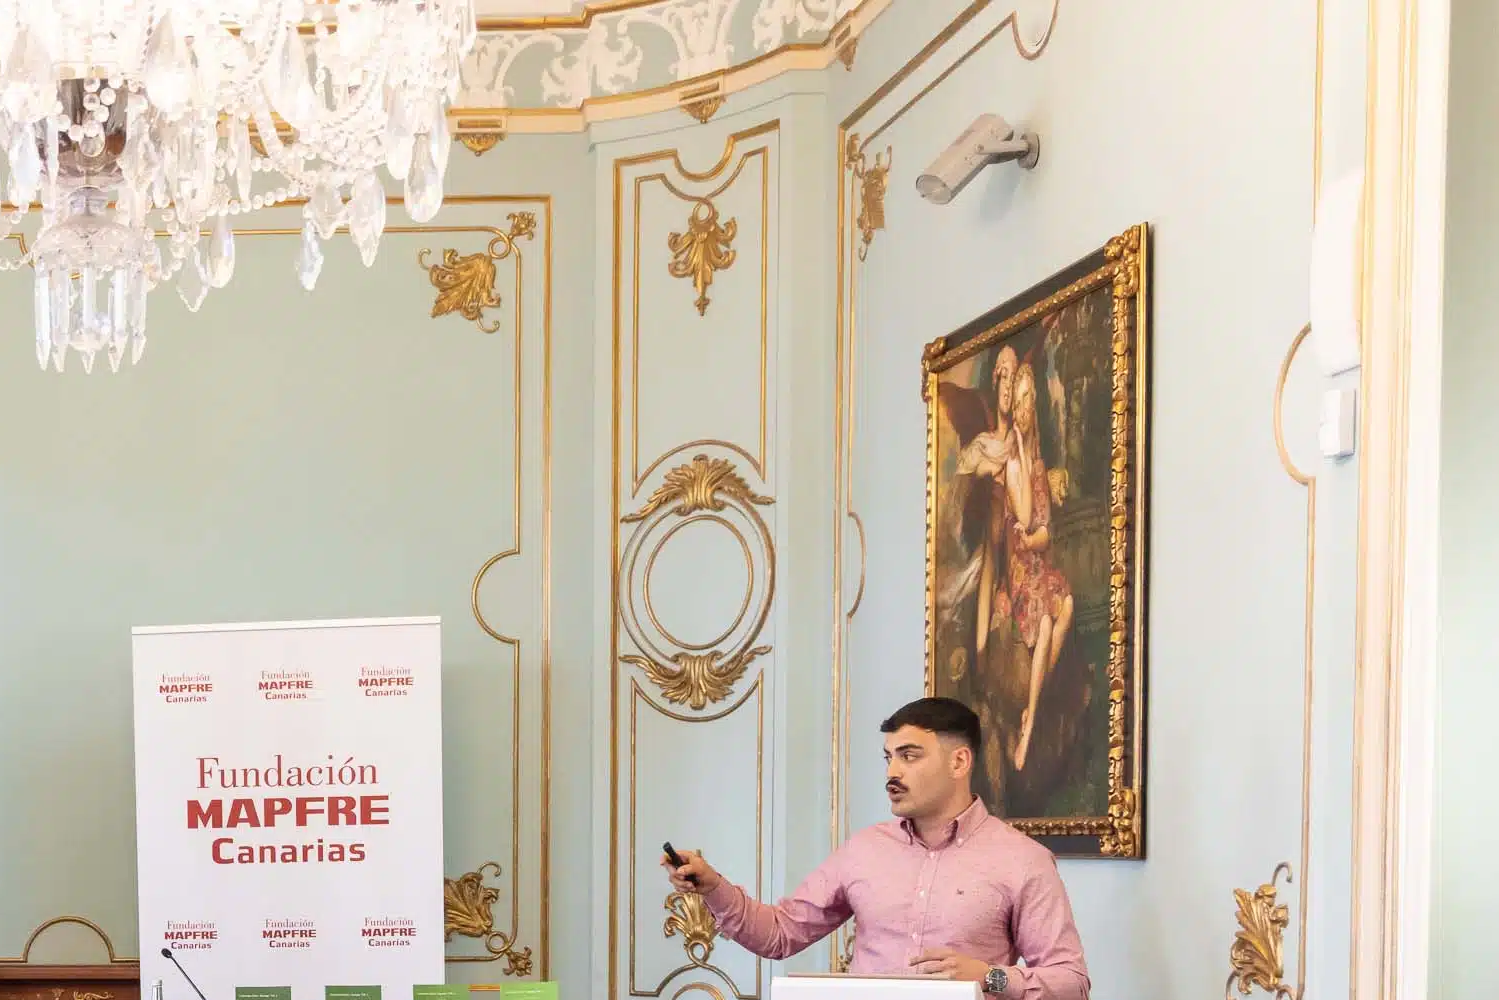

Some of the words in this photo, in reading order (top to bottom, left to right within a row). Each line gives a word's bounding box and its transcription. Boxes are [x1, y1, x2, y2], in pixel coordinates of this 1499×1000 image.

[261, 669, 310, 680] Fundación
[361, 666, 411, 677] Fundación
[161, 672, 211, 683] Fundación
[358, 677, 414, 687] MAPFRE
[159, 683, 213, 693] MAPFRE
[258, 680, 313, 690] MAPFRE
[265, 692, 307, 700] Canarias
[365, 688, 407, 697] Canarias
[166, 695, 207, 704] Canarias
[197, 755, 377, 788] Fundación
[187, 796, 389, 828] MAPFRE
[212, 838, 365, 864] Canarias
[166, 920, 215, 930] Fundación
[265, 918, 314, 929] Fundación
[364, 917, 414, 927] Fundación
[164, 930, 218, 940] MAPFRE
[262, 929, 317, 939] MAPFRE
[362, 927, 416, 937] MAPFRE
[171, 940, 212, 950] Canarias
[269, 940, 311, 949] Canarias
[368, 938, 410, 947] Canarias
